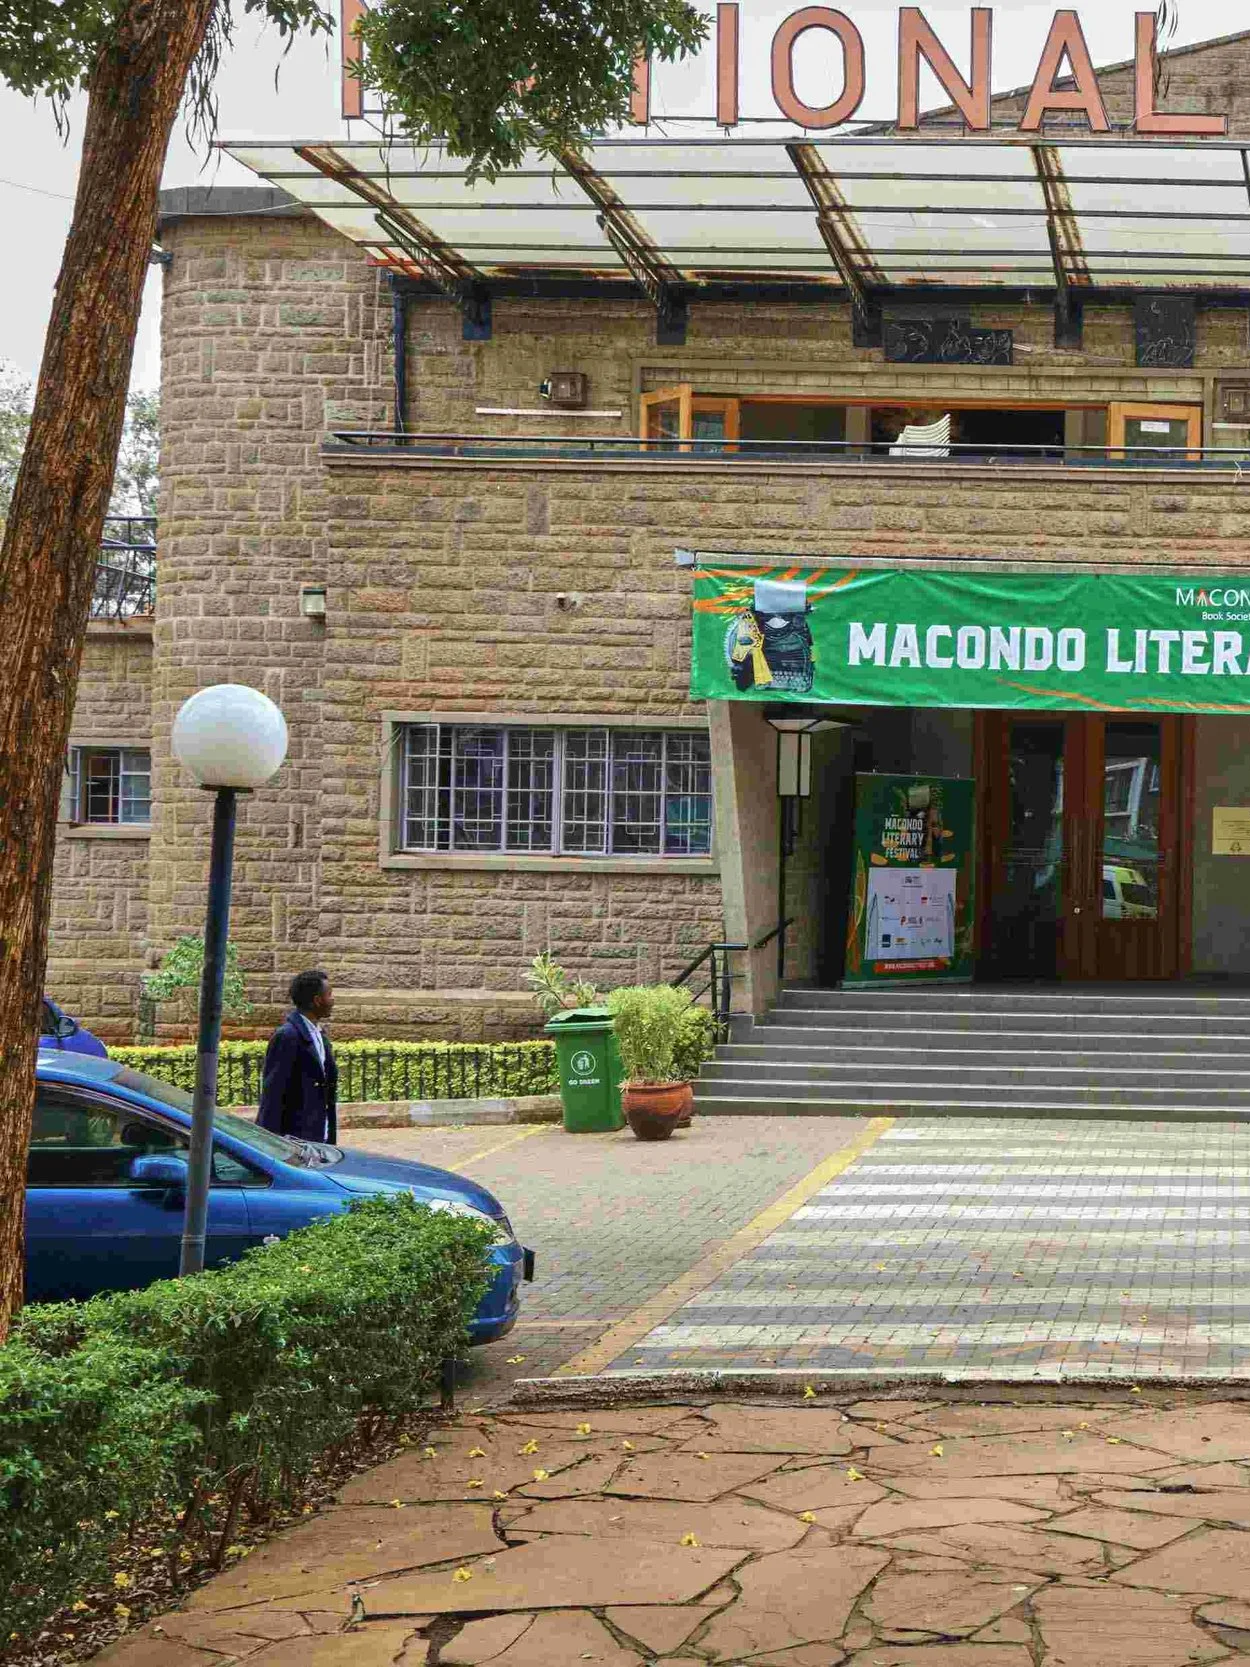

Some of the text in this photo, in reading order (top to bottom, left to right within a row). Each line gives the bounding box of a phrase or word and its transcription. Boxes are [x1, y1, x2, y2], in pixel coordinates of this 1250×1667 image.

[341, 0, 1228, 136] IONAL
[1202, 611, 1224, 621] Book
[847, 622, 1086, 673] MACONDO
[884, 817, 923, 830] MACONDO
[881, 832, 924, 846] LITERARY
[885, 848, 920, 859] FESTIVAL
